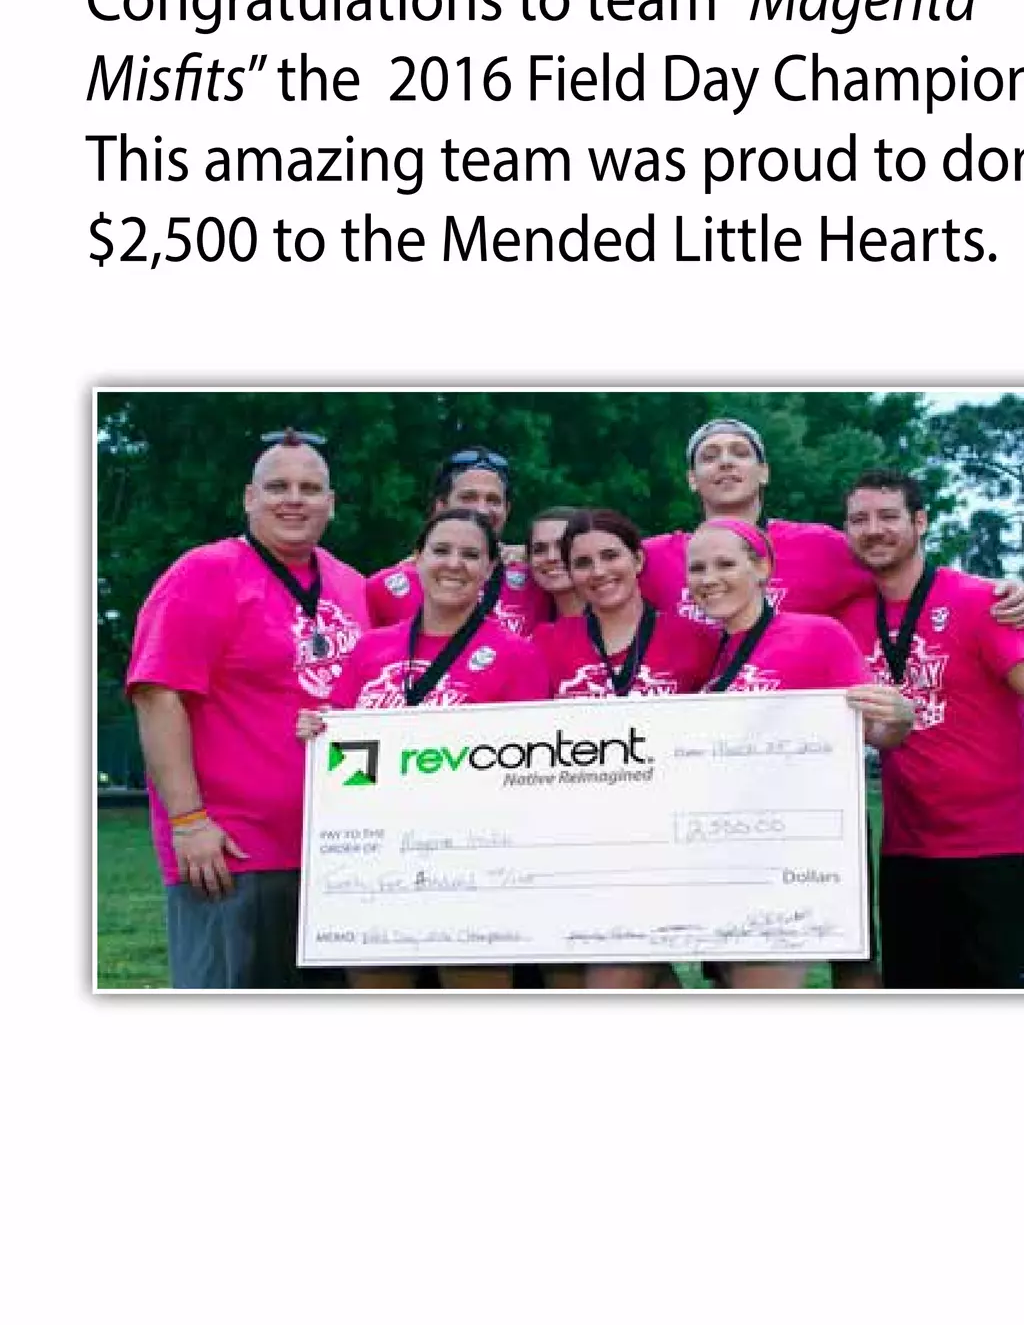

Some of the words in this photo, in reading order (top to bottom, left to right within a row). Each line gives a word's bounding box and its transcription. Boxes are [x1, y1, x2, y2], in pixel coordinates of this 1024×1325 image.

[278, 53, 359, 101] the
[390, 56, 511, 101] 2016
[531, 53, 644, 101] Field
[666, 55, 759, 115] Day
[86, 133, 188, 181] This
[206, 136, 422, 195] amazing
[441, 139, 569, 181] team
[588, 148, 685, 181] was
[705, 133, 856, 194] proud
[874, 139, 925, 181] to
[90, 212, 257, 269] $2,500
[273, 220, 324, 262] to
[341, 214, 425, 262] the
[444, 214, 654, 262] Mended
[677, 213, 801, 262] Little
[821, 216, 996, 262] Hearts.
[782, 868, 841, 884] Dollars
